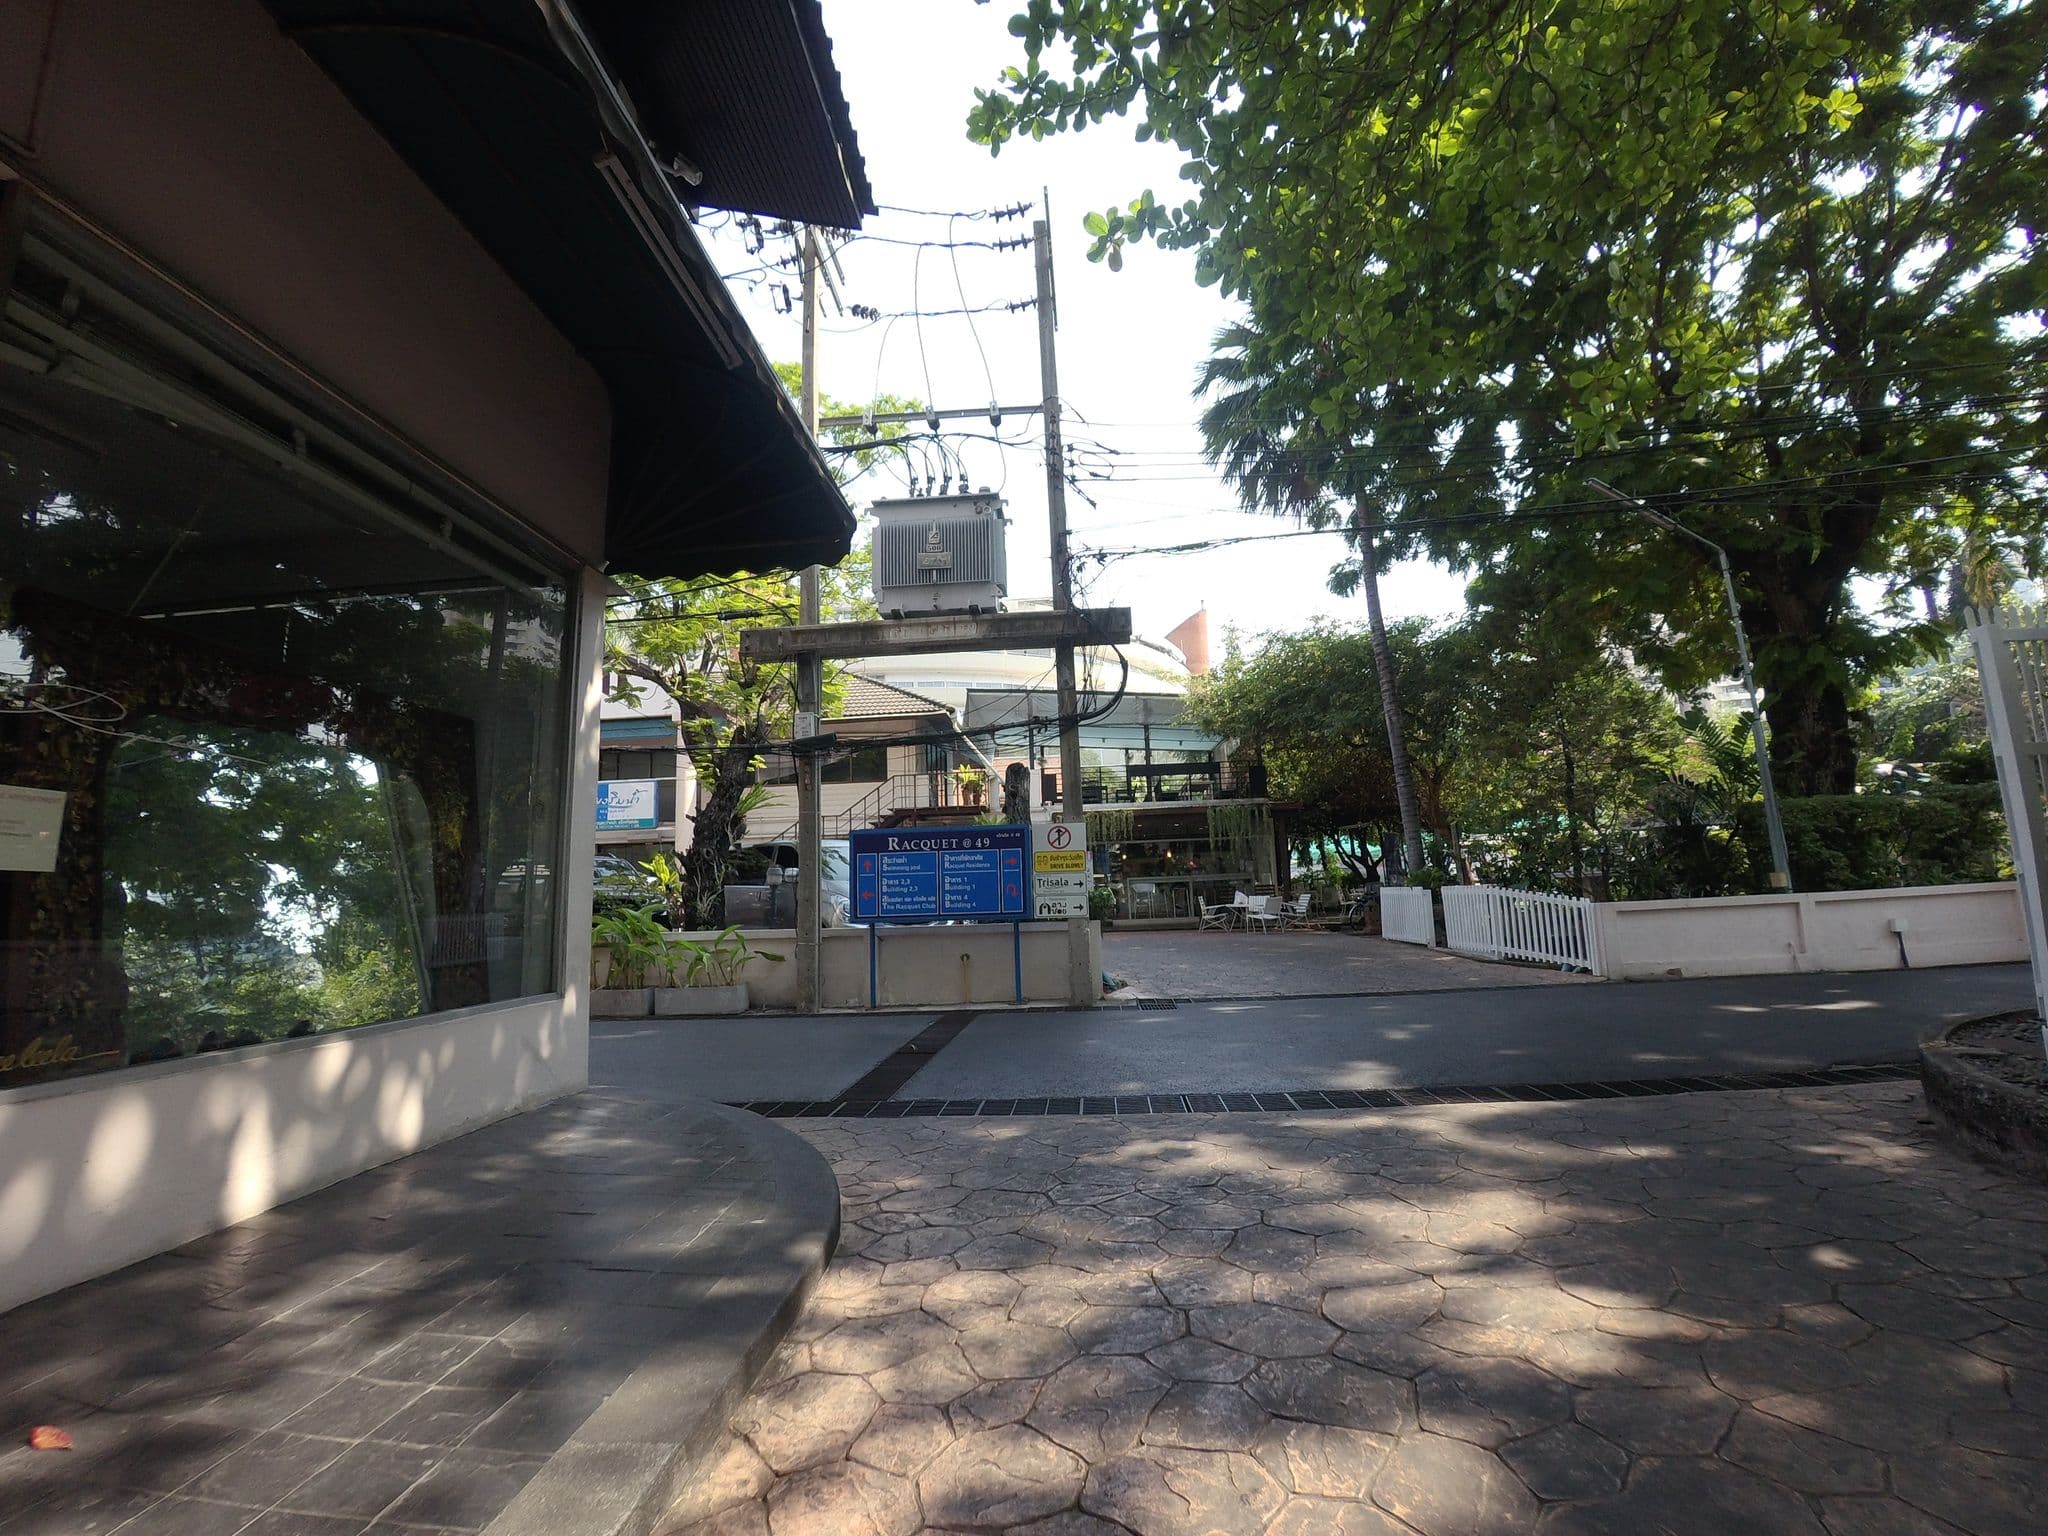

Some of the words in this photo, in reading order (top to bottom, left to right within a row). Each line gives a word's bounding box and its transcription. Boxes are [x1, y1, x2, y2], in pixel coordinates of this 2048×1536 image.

[888, 837, 959, 850] RACQUET
[975, 838, 990, 848] 49
[1037, 877, 1069, 889] Trisala
